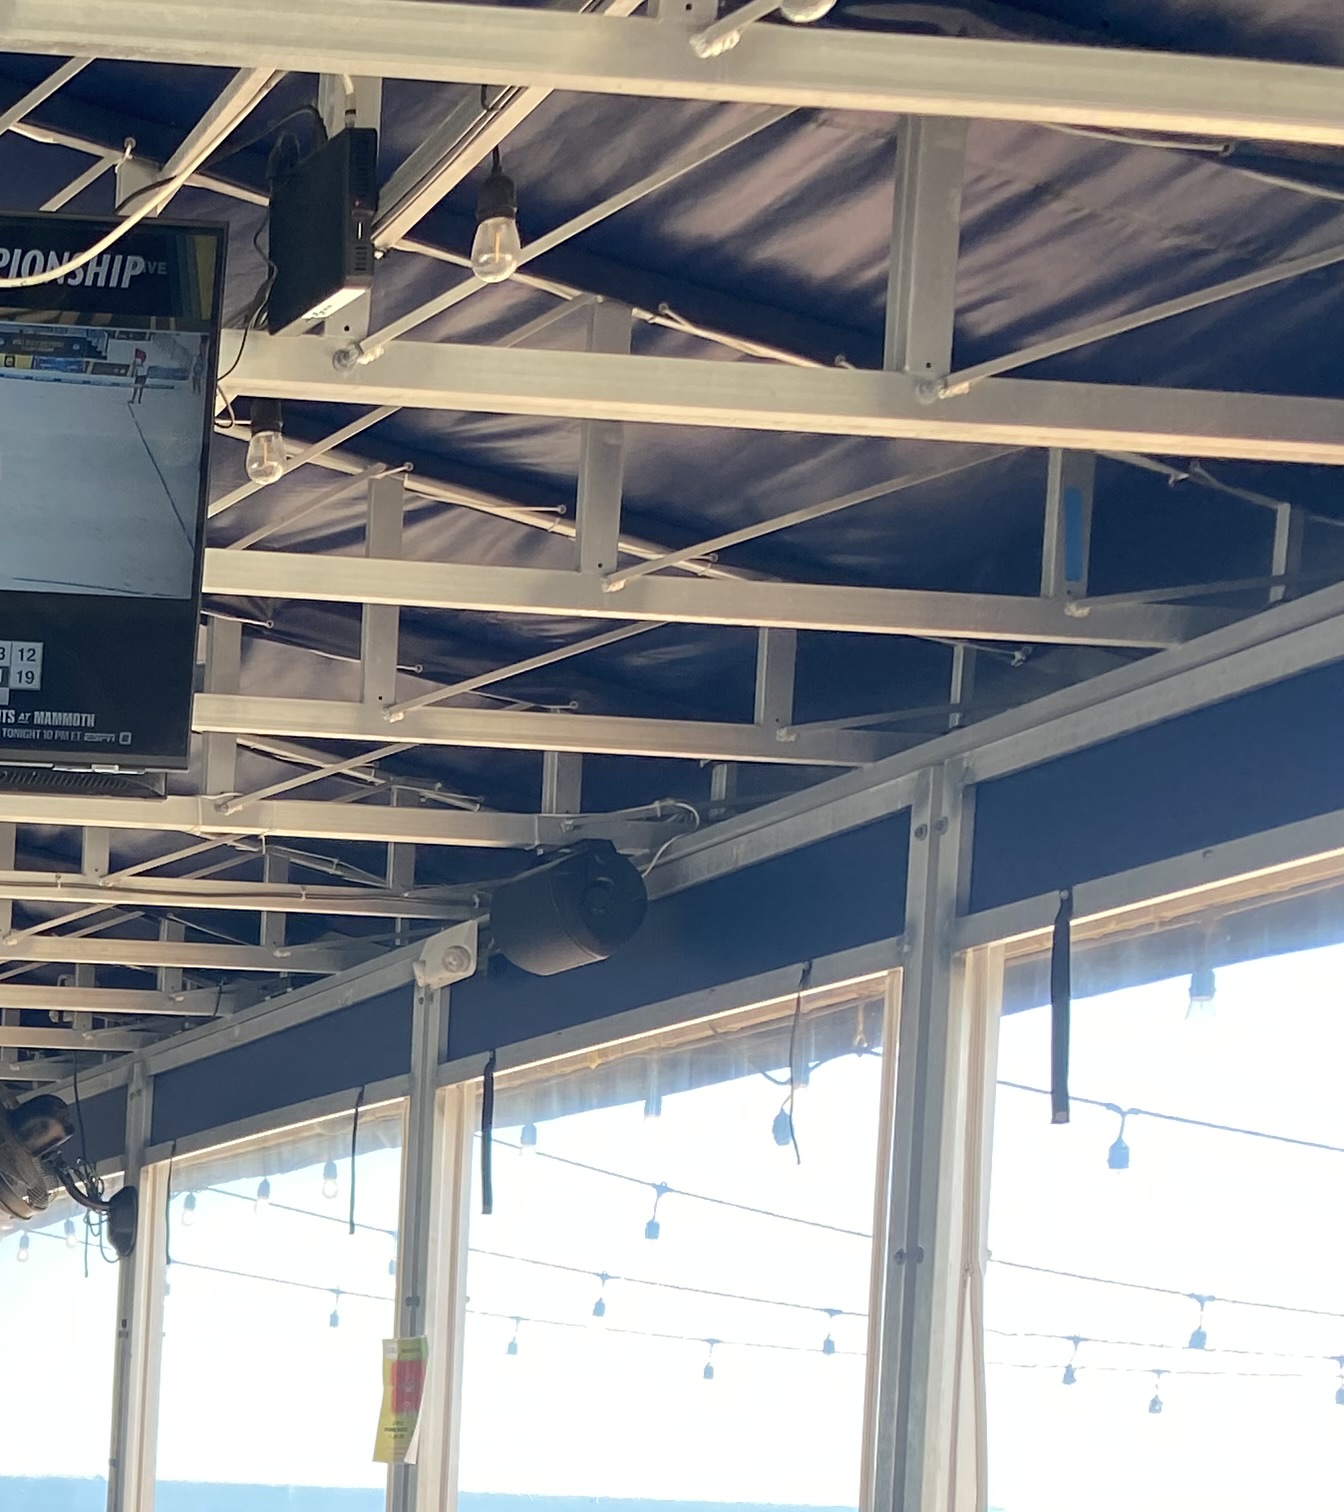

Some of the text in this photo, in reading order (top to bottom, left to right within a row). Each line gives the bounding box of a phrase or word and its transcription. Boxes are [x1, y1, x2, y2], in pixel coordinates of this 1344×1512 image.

[18, 648, 36, 663] 12
[17, 670, 35, 684] 19
[33, 711, 95, 727] MAMMOTH
[2, 728, 41, 740] TONIGHT
